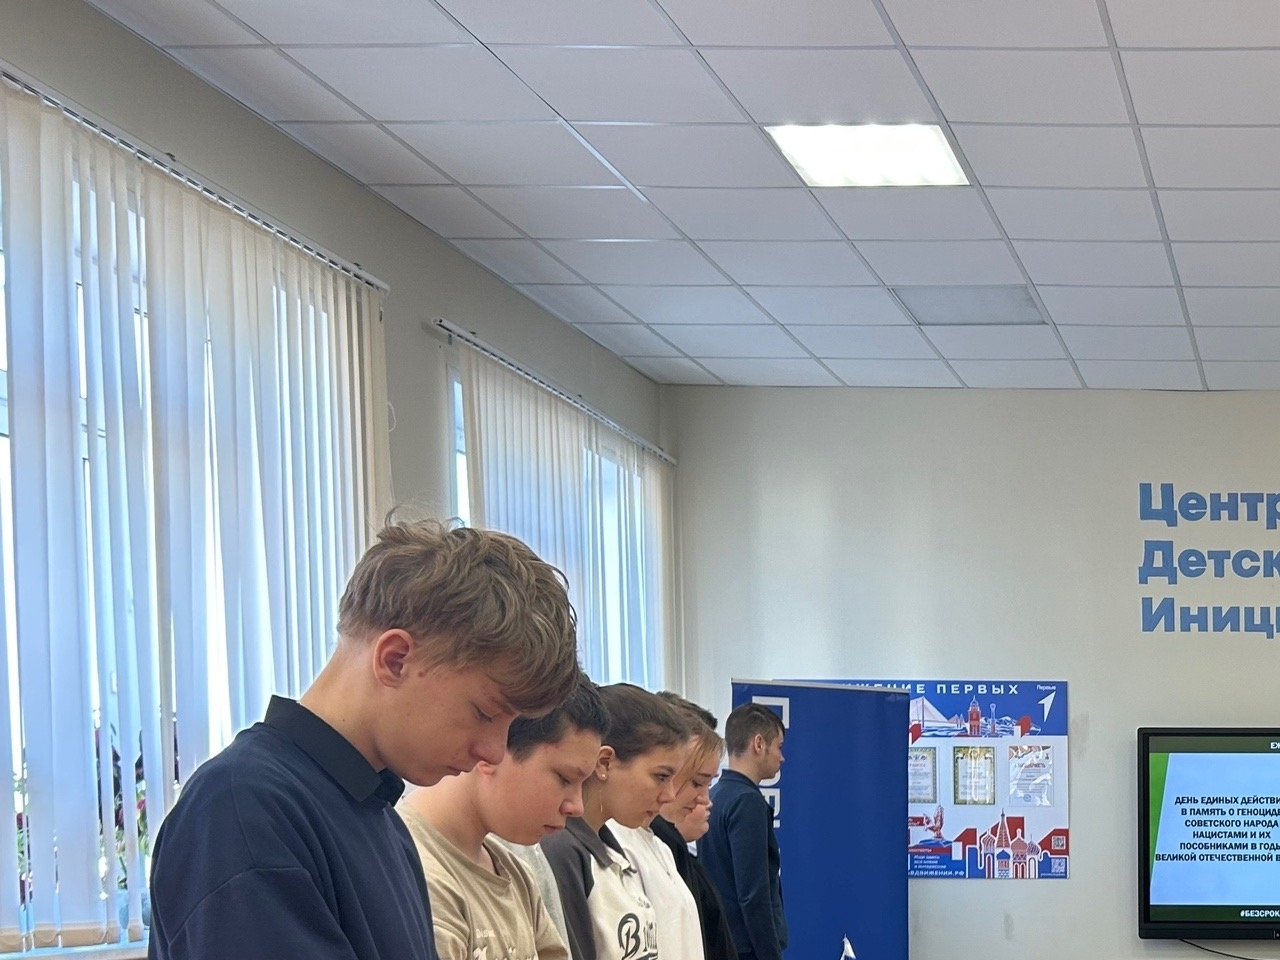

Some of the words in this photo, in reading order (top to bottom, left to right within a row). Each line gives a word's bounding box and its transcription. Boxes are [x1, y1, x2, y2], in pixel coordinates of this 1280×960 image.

[936, 684, 1019, 695] ПЕРВЫХ
[1175, 797, 1199, 805] ДЕНЬ
[1201, 797, 1239, 805] ЕДИНЫХ
[1181, 808, 1187, 816] В
[1190, 808, 1226, 816] ПАМЯТЬ
[1228, 808, 1235, 816] О
[1185, 819, 1242, 828] СОВЕТСКОГО
[1243, 819, 1279, 828] НАРОДА
[1193, 831, 1248, 840] НАЦИСТАМИ
[1250, 831, 1257, 839] И
[1259, 831, 1271, 839] ИХ
[1180, 842, 1249, 850] ПОСОБНИКАМИ
[1251, 842, 1257, 850] В
[1155, 852, 1197, 861] ВЕЛИКОЙ
[1199, 852, 1273, 862] ОТЕЧЕСТВЕННОЙ
